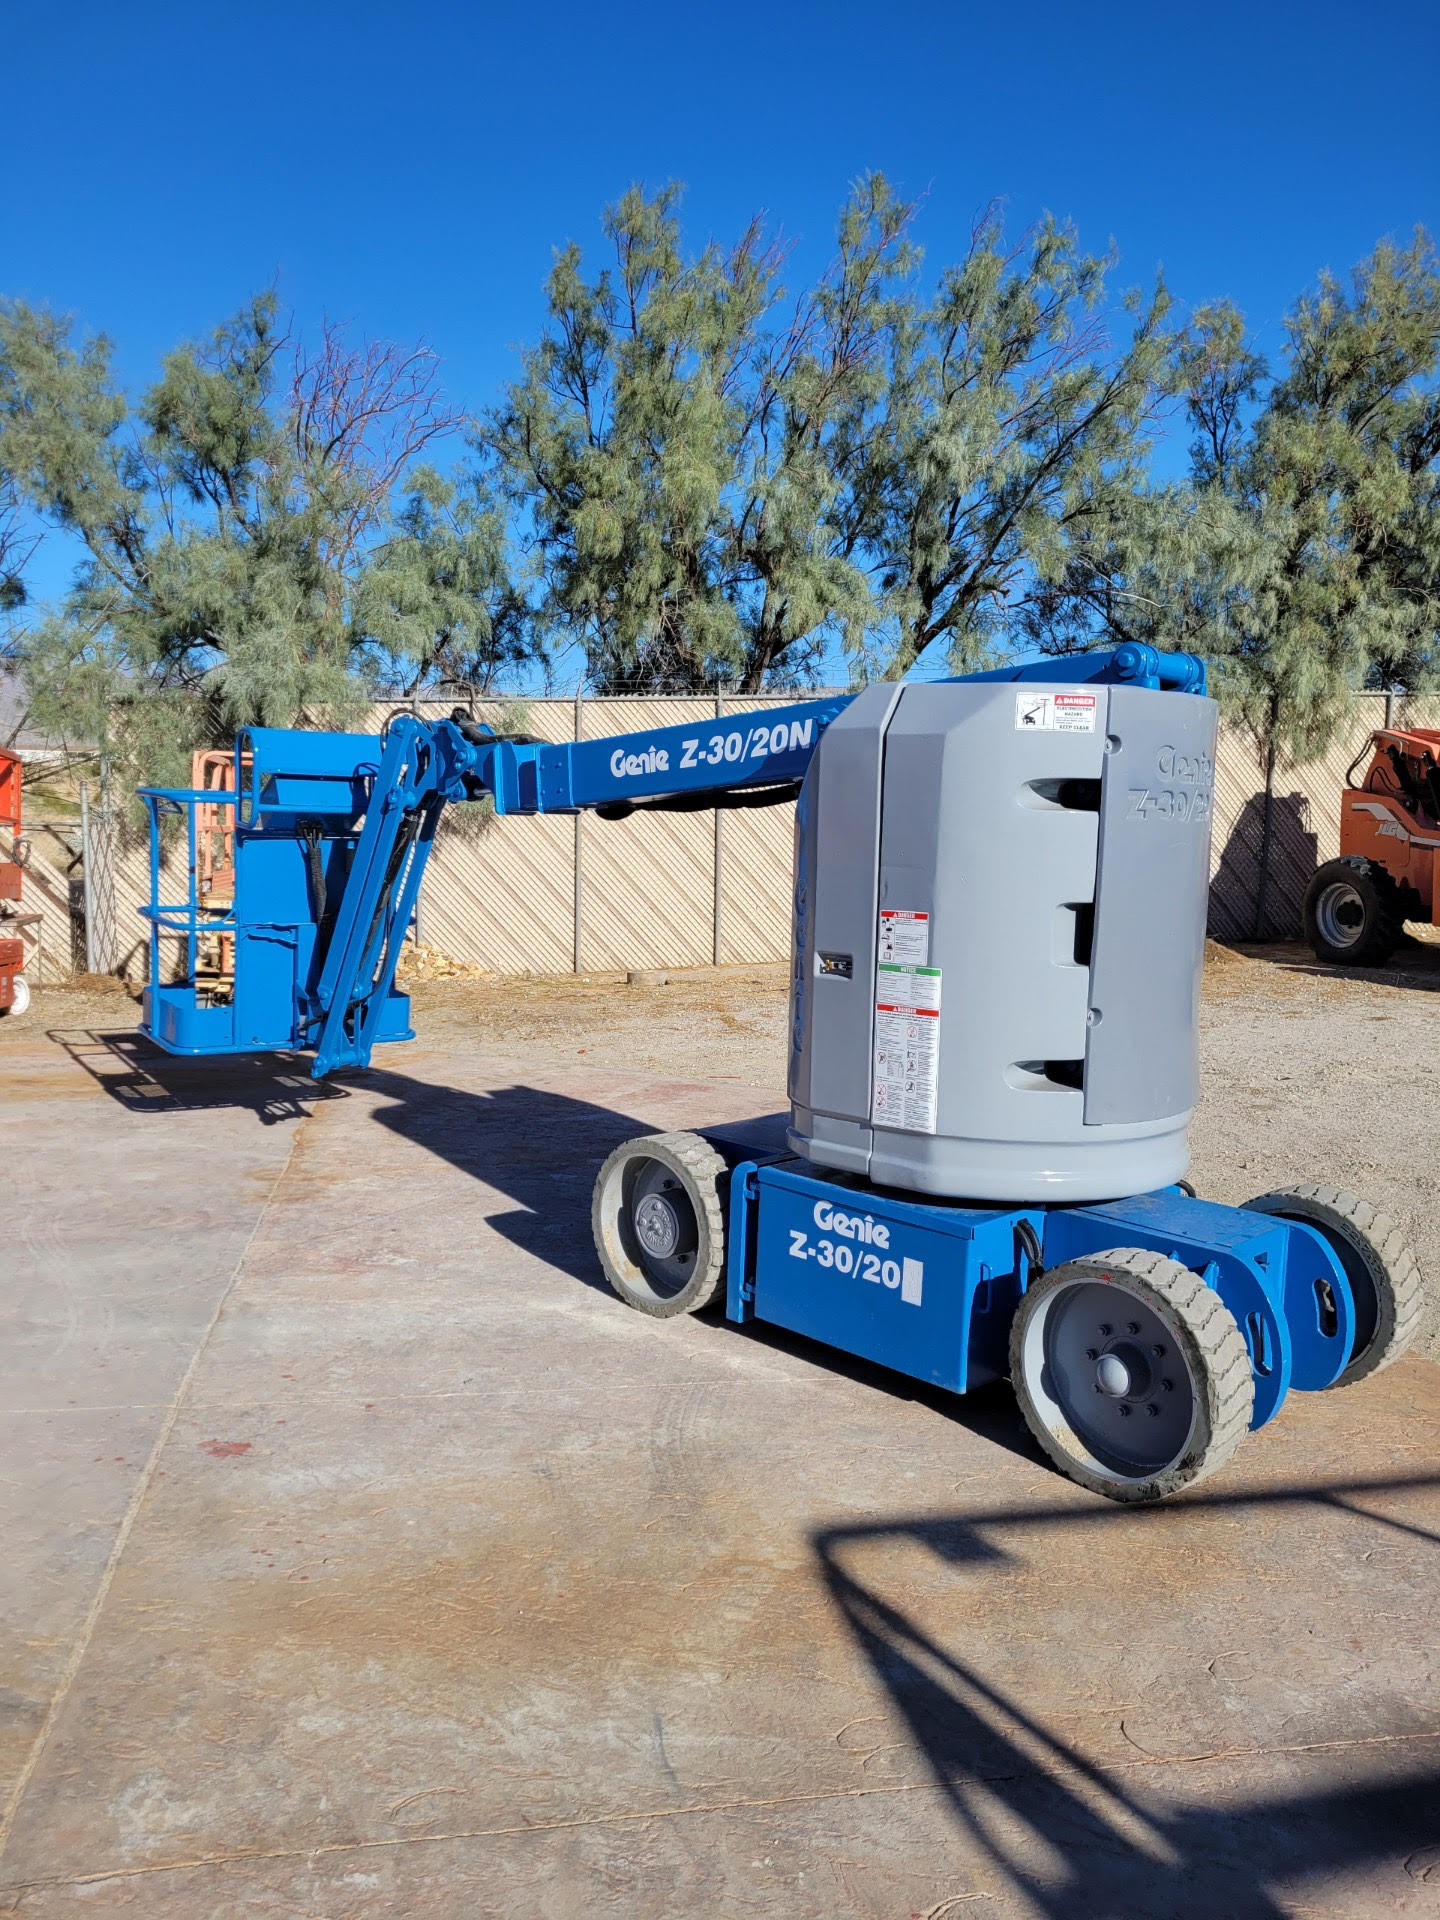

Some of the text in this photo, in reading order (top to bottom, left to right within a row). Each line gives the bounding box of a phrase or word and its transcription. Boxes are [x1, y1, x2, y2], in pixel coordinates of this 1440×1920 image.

[1063, 697, 1094, 705] DANGER
[610, 718, 813, 778] Genie Z-30/20N
[813, 1199, 890, 1250] Genie
